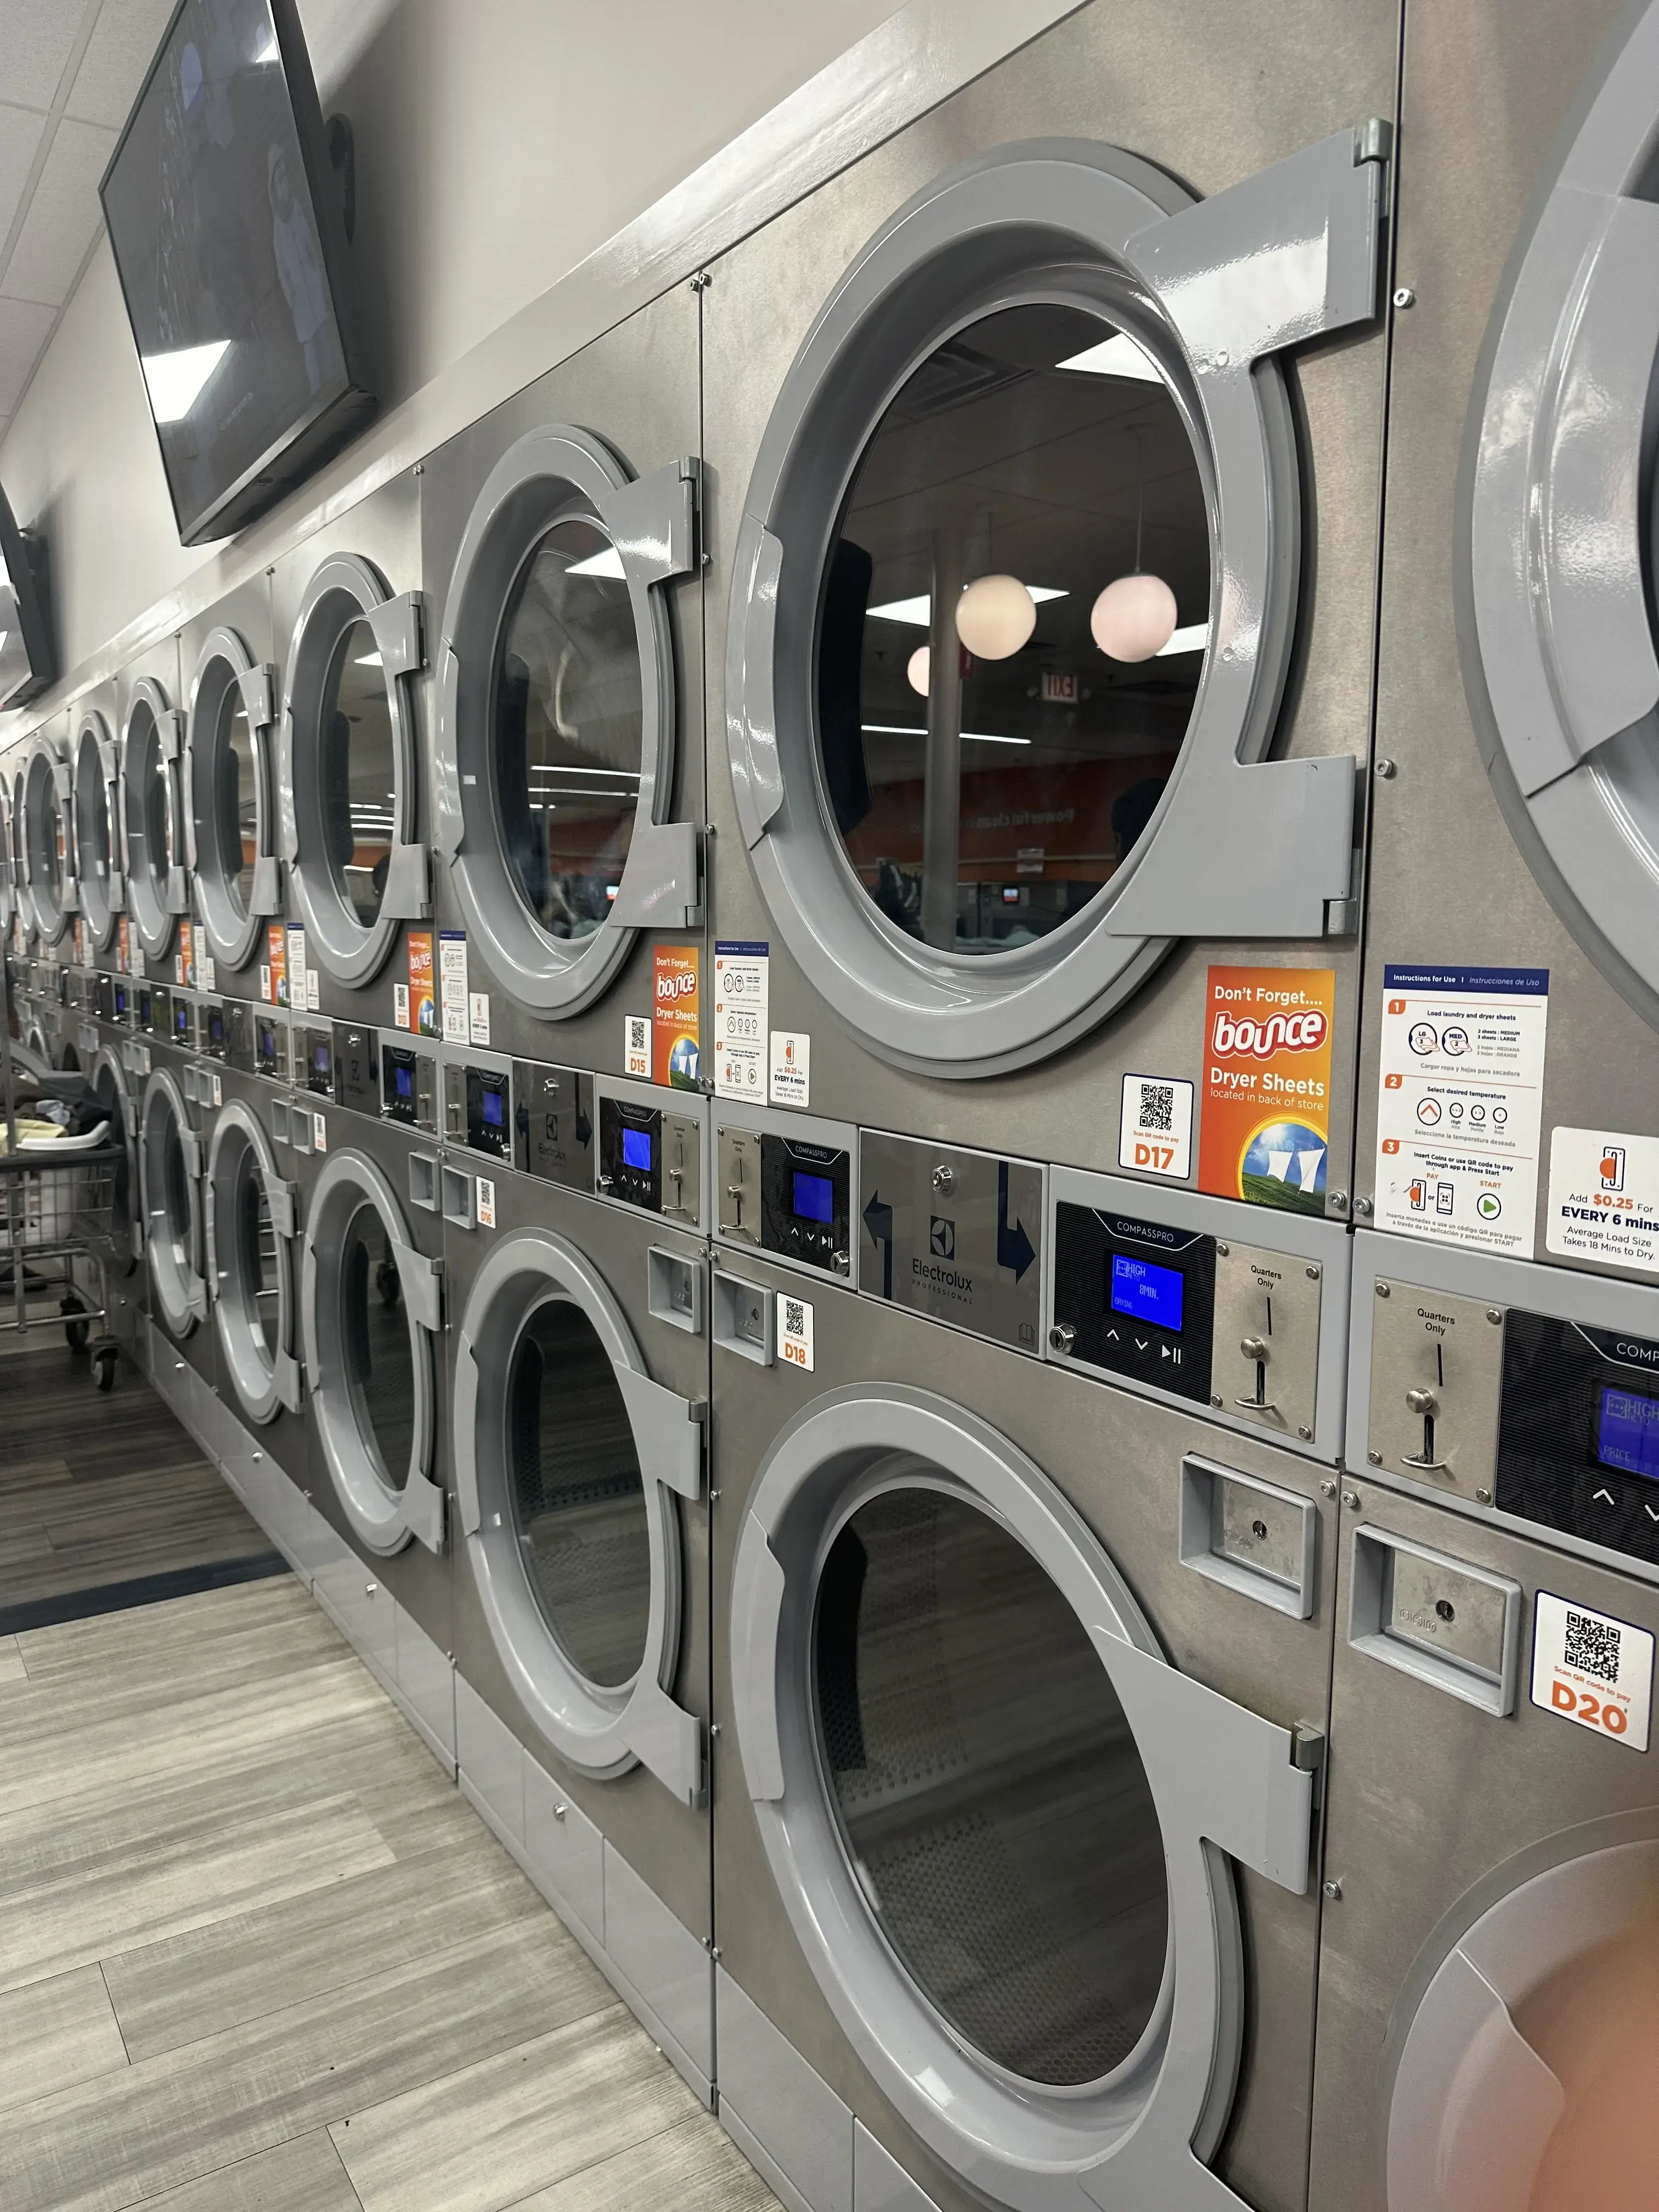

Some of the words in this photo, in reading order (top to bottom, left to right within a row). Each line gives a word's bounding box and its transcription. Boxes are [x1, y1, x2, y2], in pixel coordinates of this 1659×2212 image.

[657, 972, 696, 1000] bounce
[1215, 985, 1252, 1001] Don't
[657, 1007, 674, 1020] Dryer
[675, 1009, 697, 1022] Sheets
[1394, 1002, 1399, 1012] 1
[1213, 1011, 1325, 1057] bounce
[631, 1058, 645, 1074] D15
[1211, 1066, 1257, 1089] Dryer
[1262, 1073, 1325, 1096] Sheets
[1390, 1077, 1397, 1086] 2
[1211, 1087, 1244, 1101] located
[1247, 1092, 1255, 1102] in
[1258, 1093, 1282, 1105] back
[1284, 1097, 1295, 1107] of
[1297, 1099, 1324, 1111] store
[1469, 1090, 1506, 1099] temperature
[1414, 1129, 1444, 1138] Seleccione
[1453, 1134, 1488, 1144] temperatura
[1491, 1139, 1516, 1147] deseada
[795, 1146, 827, 1159] COMPASSPRO
[1387, 1142, 1395, 1152] 3
[1135, 1143, 1174, 1170] D17
[1426, 1160, 1448, 1169] through
[1569, 1194, 1588, 1203] Add
[1593, 1194, 1633, 1210] $0.25
[1637, 1204, 1654, 1213] For
[1406, 1215, 1431, 1224] monedas
[1561, 1206, 1609, 1223] EVERY
[1612, 1214, 1621, 1225] 6
[1626, 1218, 1659, 1232] mins
[1117, 1221, 1174, 1242] COMPASSPRO
[1567, 1226, 1604, 1239] Average
[1606, 1232, 1629, 1243] Load
[1632, 1237, 1651, 1247] Size
[1562, 1236, 1587, 1248] Takes
[1589, 1241, 1598, 1249] 18
[1601, 1243, 1621, 1254] Mins
[1637, 1249, 1655, 1260] Dry.
[912, 1257, 972, 1293] Electrolux
[1127, 1262, 1146, 1277] HIGH
[1251, 1265, 1282, 1279] Quarters
[912, 1279, 972, 1305] PROFESSIONAL
[1257, 1278, 1274, 1290] Only
[1115, 1297, 1133, 1310] DRYING
[1418, 1308, 1455, 1324] Quarters
[1425, 1322, 1446, 1336] Only
[786, 1342, 805, 1364] D18
[1604, 1445, 1630, 1462] PRICE
[1554, 1666, 1571, 1678] Scan
[1573, 1673, 1584, 1683] QR
[1586, 1679, 1605, 1691] code
[1606, 1686, 1615, 1695] to
[1616, 1692, 1631, 1703] pay
[1551, 1680, 1627, 1734] D20
